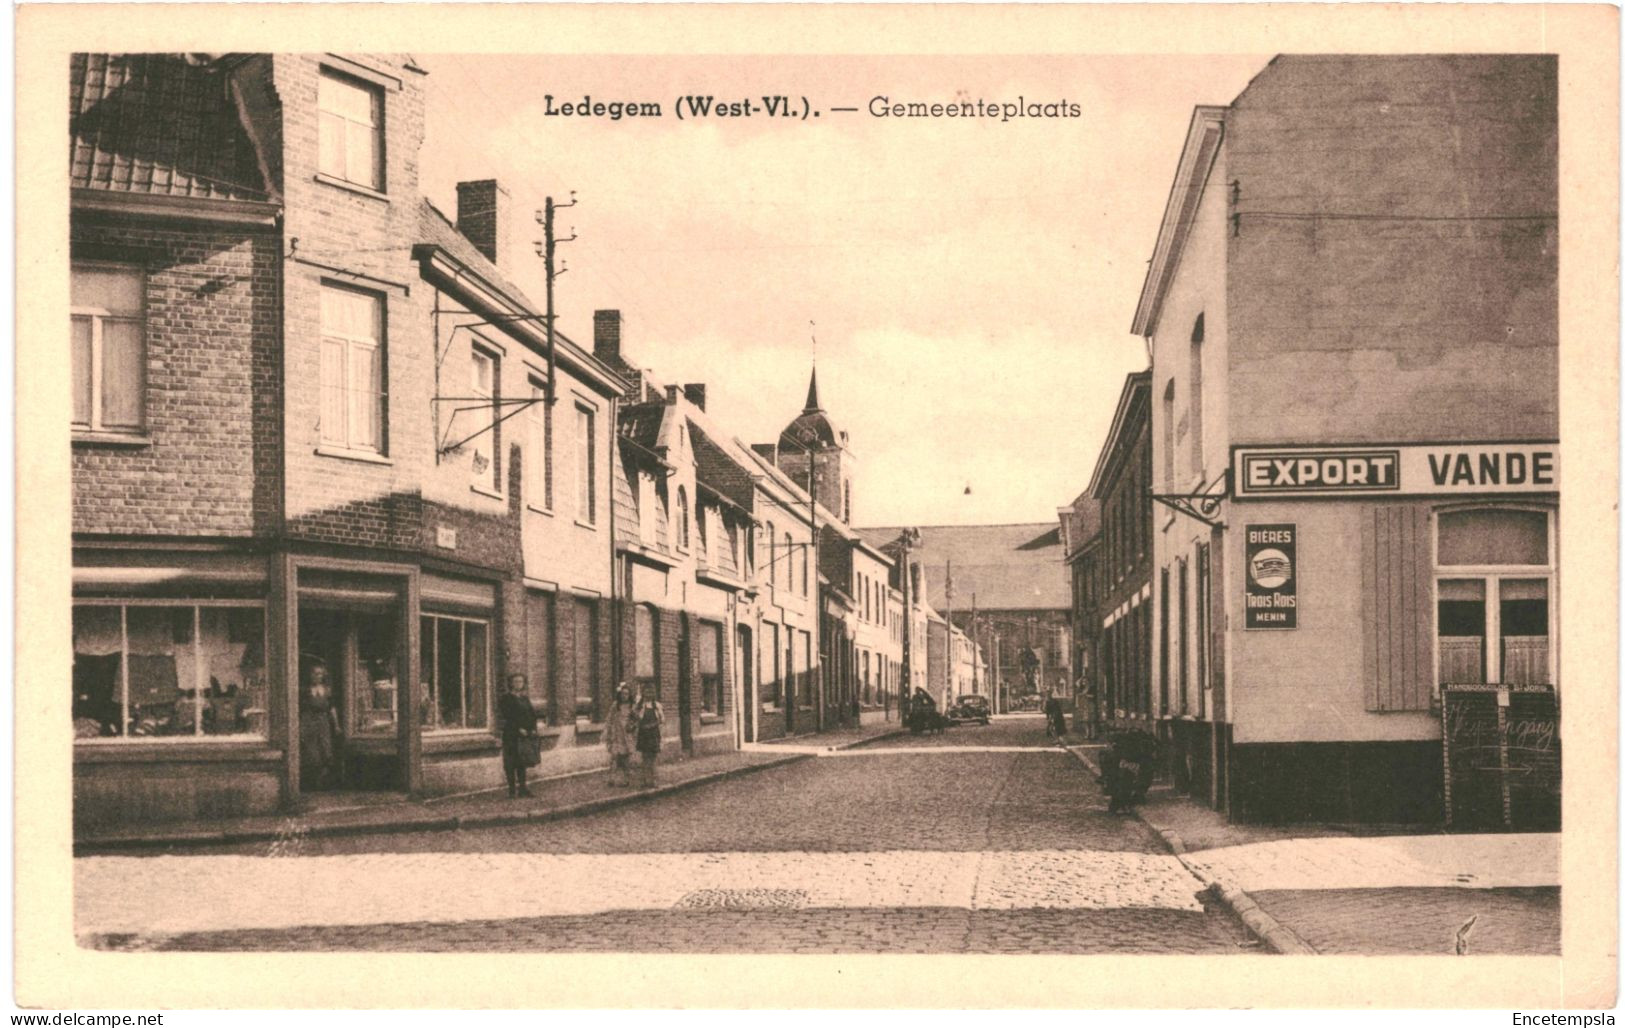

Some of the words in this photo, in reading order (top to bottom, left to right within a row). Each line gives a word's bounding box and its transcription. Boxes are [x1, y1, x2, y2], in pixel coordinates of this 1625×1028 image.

[1249, 458, 1393, 486] EXPORT
[1428, 452, 1554, 486] VANDE
[1256, 613, 1287, 622] MENIN
